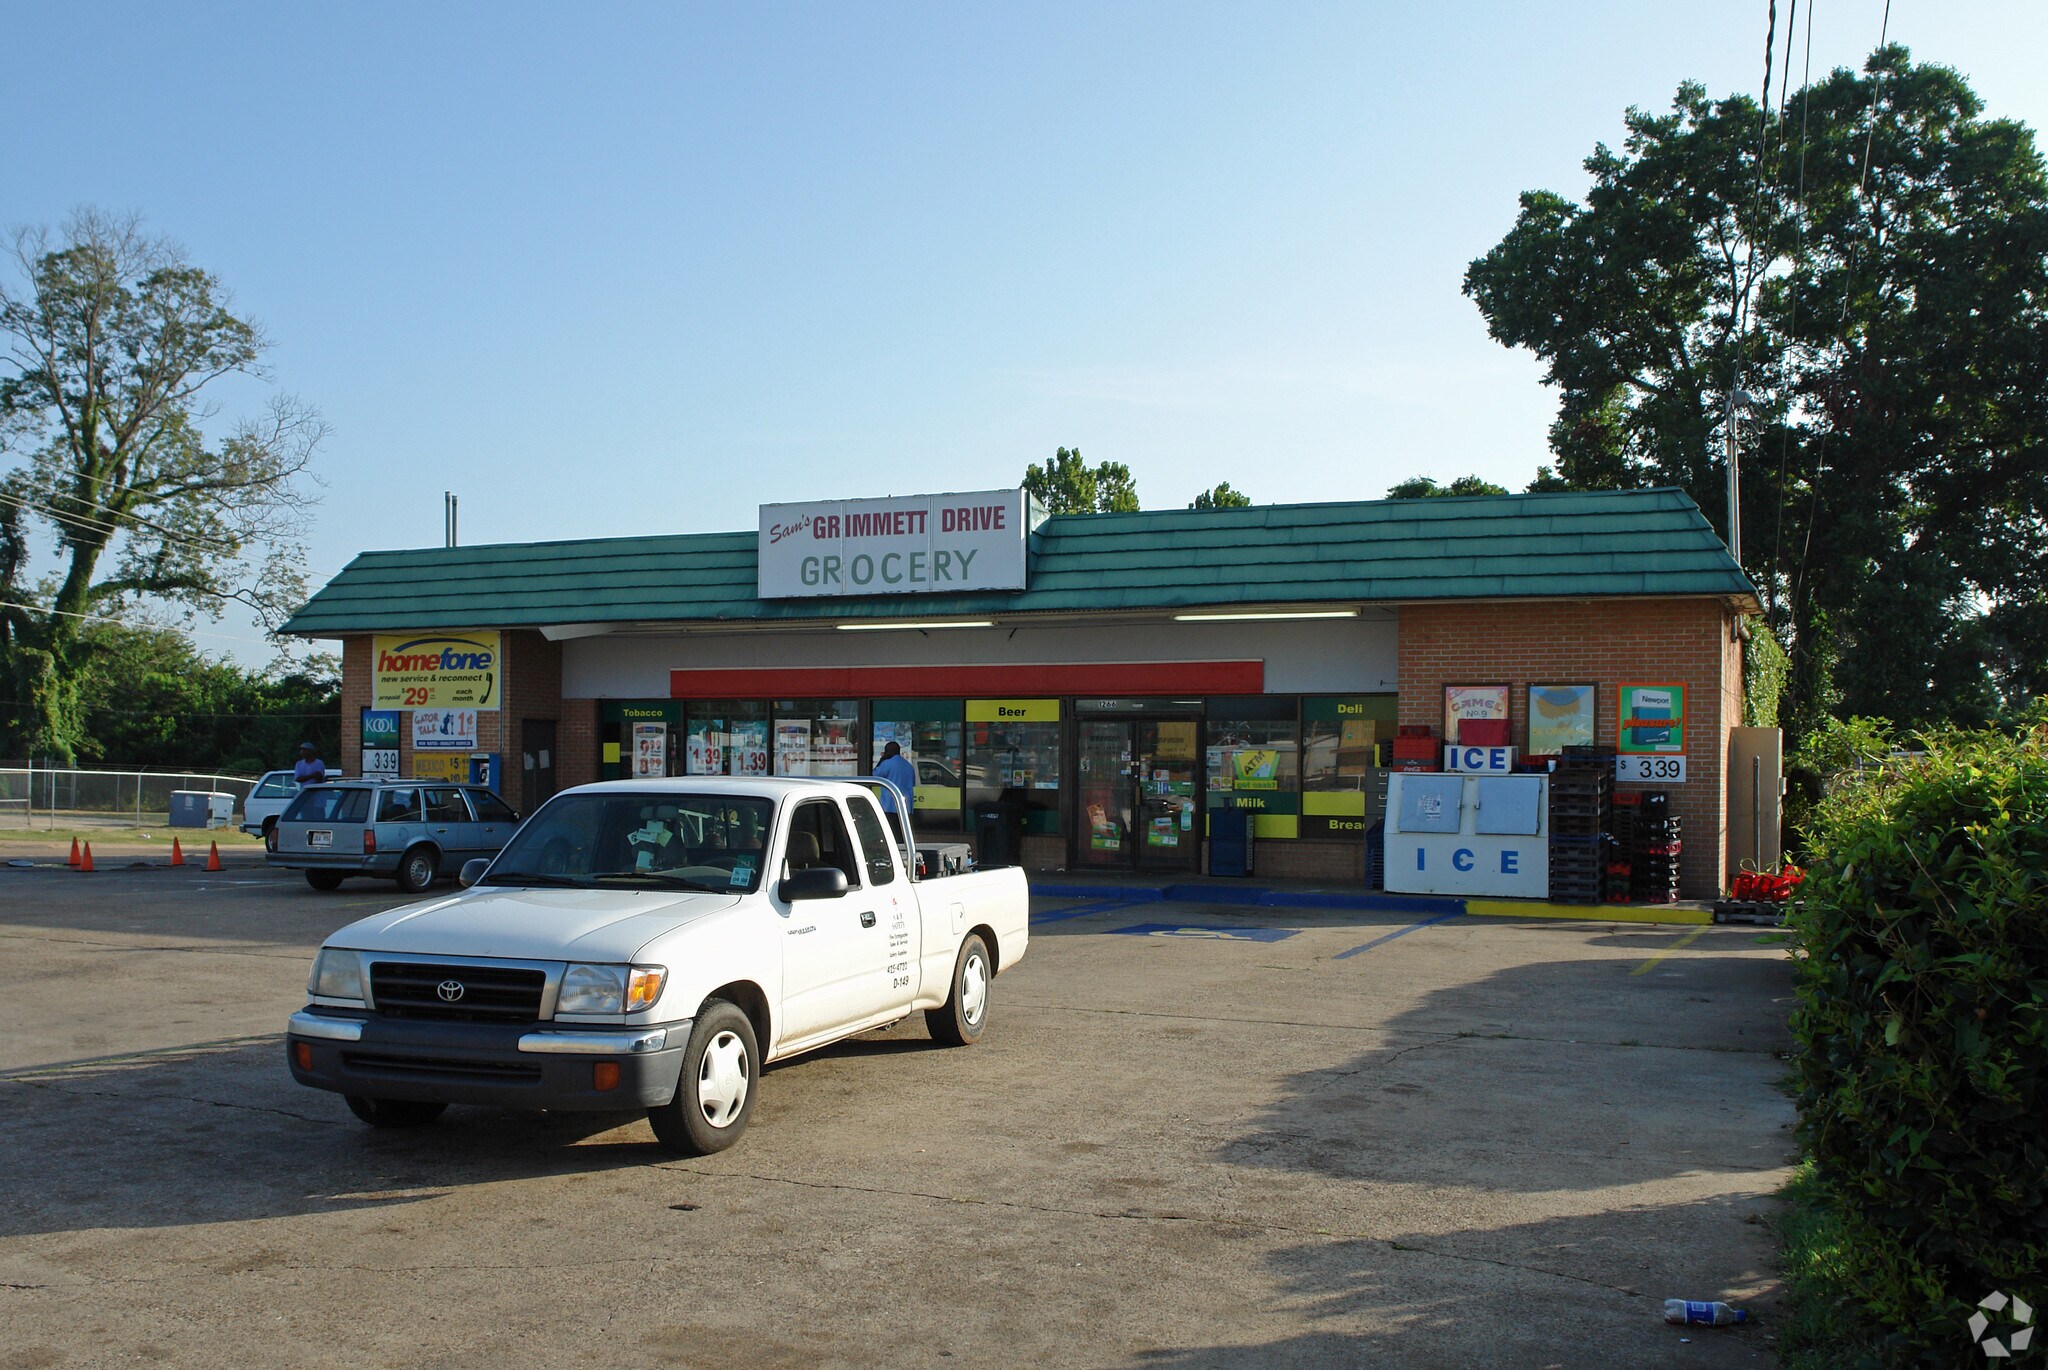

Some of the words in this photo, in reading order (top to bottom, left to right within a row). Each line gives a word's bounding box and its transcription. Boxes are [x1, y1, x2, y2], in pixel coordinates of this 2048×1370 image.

[770, 514, 812, 543] Sam's
[813, 510, 928, 539] GRIMMETT
[942, 506, 1005, 532] DRIVE
[800, 549, 978, 586] GROCERY
[378, 647, 492, 672] homefone
[438, 674, 482, 682] reconnect
[378, 694, 401, 702] prepaid
[1642, 695, 1670, 704] Newport
[998, 707, 1027, 717] Beer
[1337, 704, 1363, 714] Deli
[1450, 698, 1503, 713] CAMEL
[623, 709, 663, 717] Tobacco
[365, 718, 396, 733] KOOL
[1244, 750, 1266, 775] ATM
[1451, 747, 1506, 770] ICE
[1620, 760, 1627, 770] $
[1639, 760, 1680, 779] 3.39
[1237, 781, 1251, 790] got
[1236, 797, 1265, 808] Milk
[1417, 848, 1519, 874] ICE
[893, 976, 910, 989] D-149
